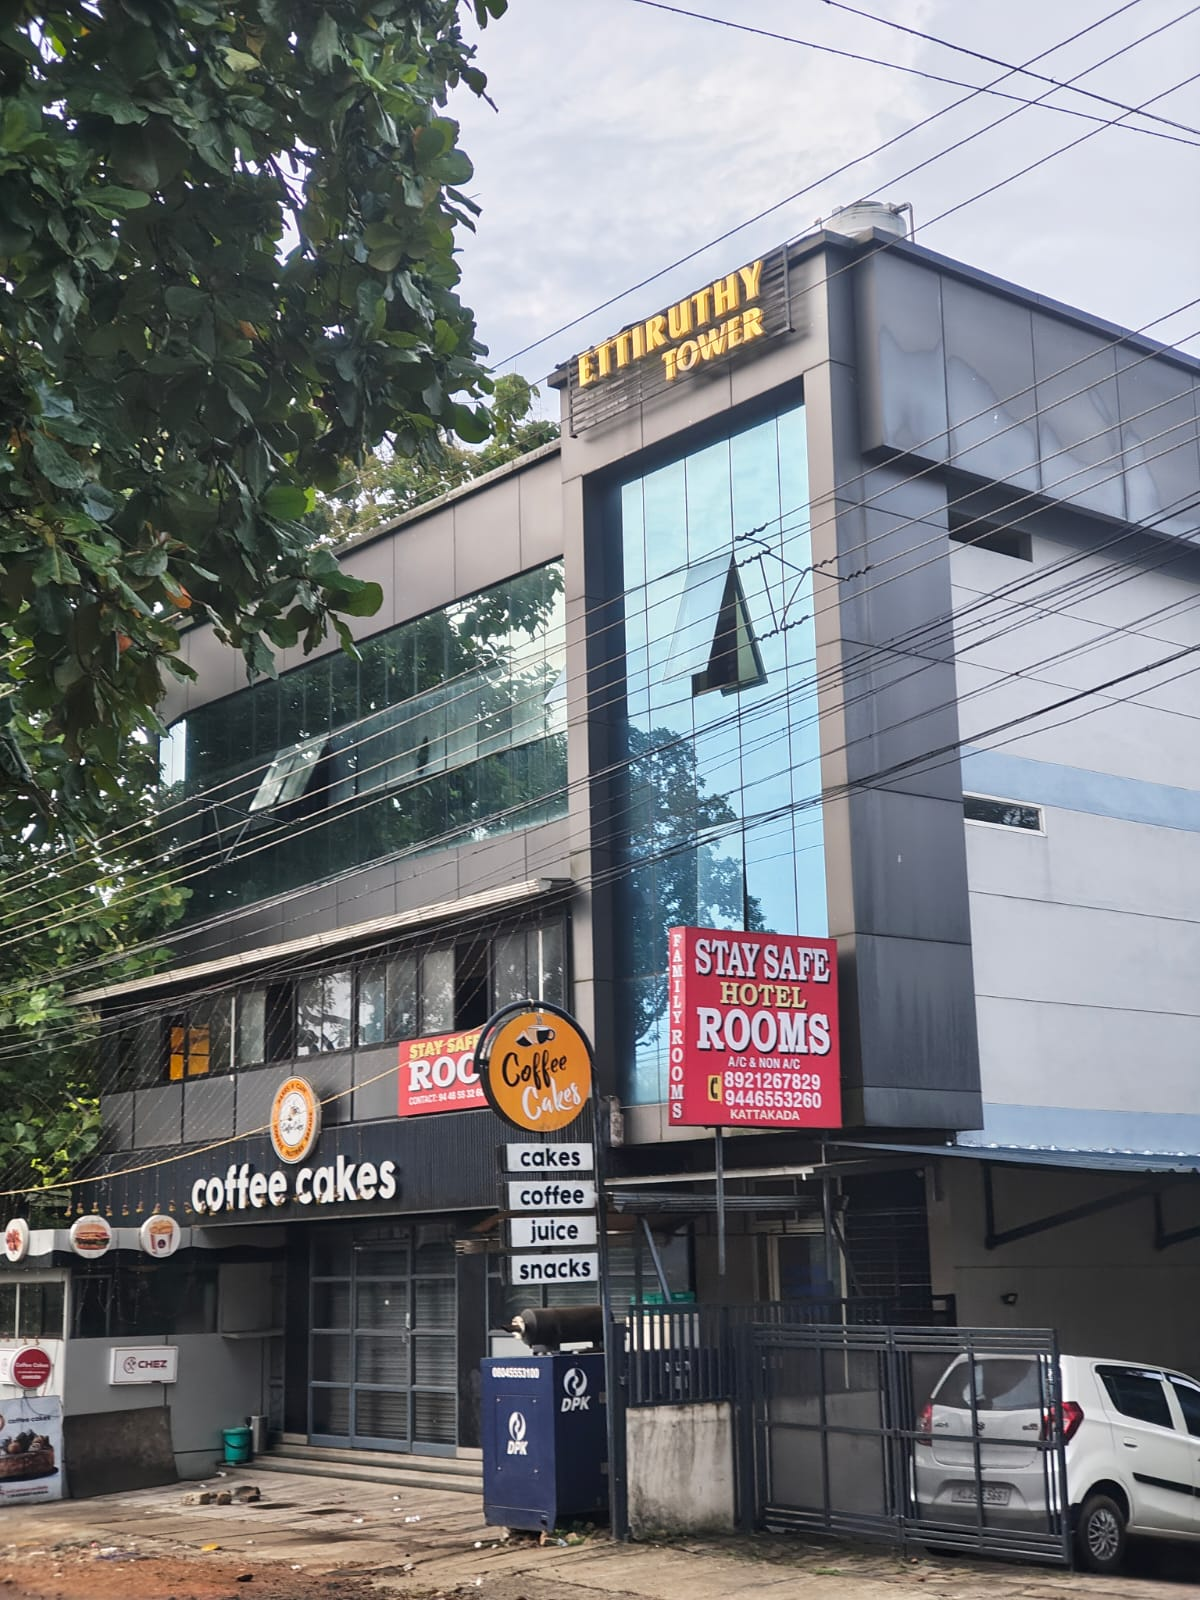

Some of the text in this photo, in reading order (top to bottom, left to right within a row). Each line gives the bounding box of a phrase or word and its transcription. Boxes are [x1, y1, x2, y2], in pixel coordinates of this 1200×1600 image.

[577, 260, 763, 388] ETTIRUTHY
[661, 307, 764, 381] TOWER
[695, 939, 830, 983] STAY SAFE
[720, 981, 807, 1009] HOTEL
[671, 934, 684, 1119] FAMILY ROOMS
[697, 1007, 831, 1055] ROOMS
[410, 1040, 443, 1059] STAY
[502, 1050, 567, 1090] Coffee
[728, 1056, 800, 1069] A/C & NON A/C
[724, 1071, 821, 1090] 8921267829
[522, 1077, 581, 1120] Cakes
[725, 1090, 822, 1109] 9446553260
[730, 1109, 800, 1120] KATTAKADA
[520, 1148, 581, 1167] cakes
[191, 1155, 396, 1214] coffee cakes
[520, 1185, 584, 1206] coffee
[530, 1220, 578, 1243] juice
[519, 1258, 591, 1280] snacks
[138, 1360, 168, 1368] CHEZ
[561, 1396, 590, 1412] DPK
[507, 1441, 528, 1455] DPK
